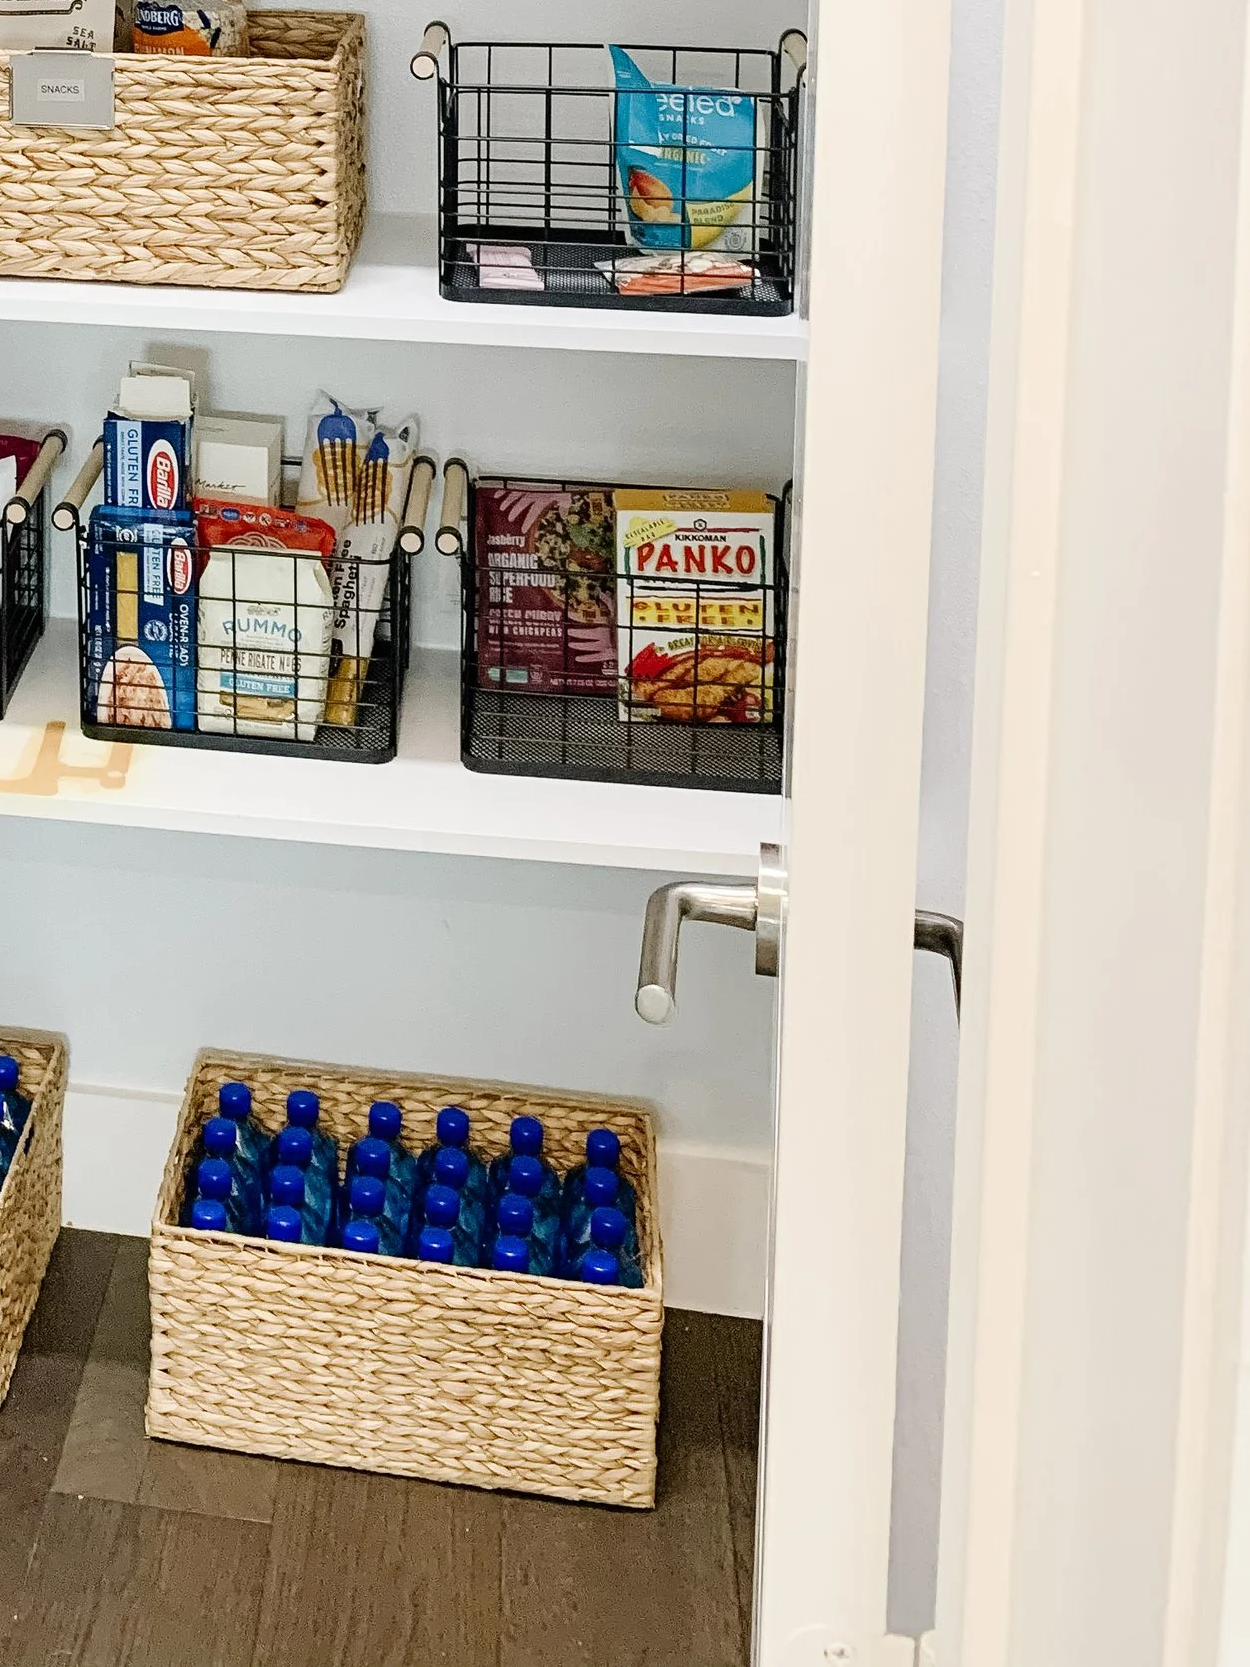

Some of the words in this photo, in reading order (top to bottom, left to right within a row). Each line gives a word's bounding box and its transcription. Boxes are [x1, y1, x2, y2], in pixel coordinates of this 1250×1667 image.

[72, 26, 95, 40] SEA
[66, 36, 97, 49] SALT
[40, 84, 80, 95] SNACKS
[658, 113, 705, 125] SNAKS
[693, 214, 725, 224] BLEND
[127, 428, 139, 482] GLUTEN
[156, 456, 172, 509] Barilla
[674, 533, 727, 543] KIKKOMAN
[151, 528, 162, 575] GLTEN
[335, 539, 351, 572] Fee
[636, 540, 756, 575] PANKO
[487, 552, 539, 569] ORGANIC
[174, 550, 188, 593] Barilla
[488, 586, 514, 603] RICE
[633, 601, 760, 615] GLUTEN
[657, 614, 735, 625] FREE
[222, 617, 303, 643] RUMMO
[488, 624, 510, 634] WIH
[512, 626, 563, 637] CHICKPEAS
[247, 652, 276, 670] RIGATE
[229, 677, 265, 691] GLUTEN
[266, 682, 291, 694] FREE
